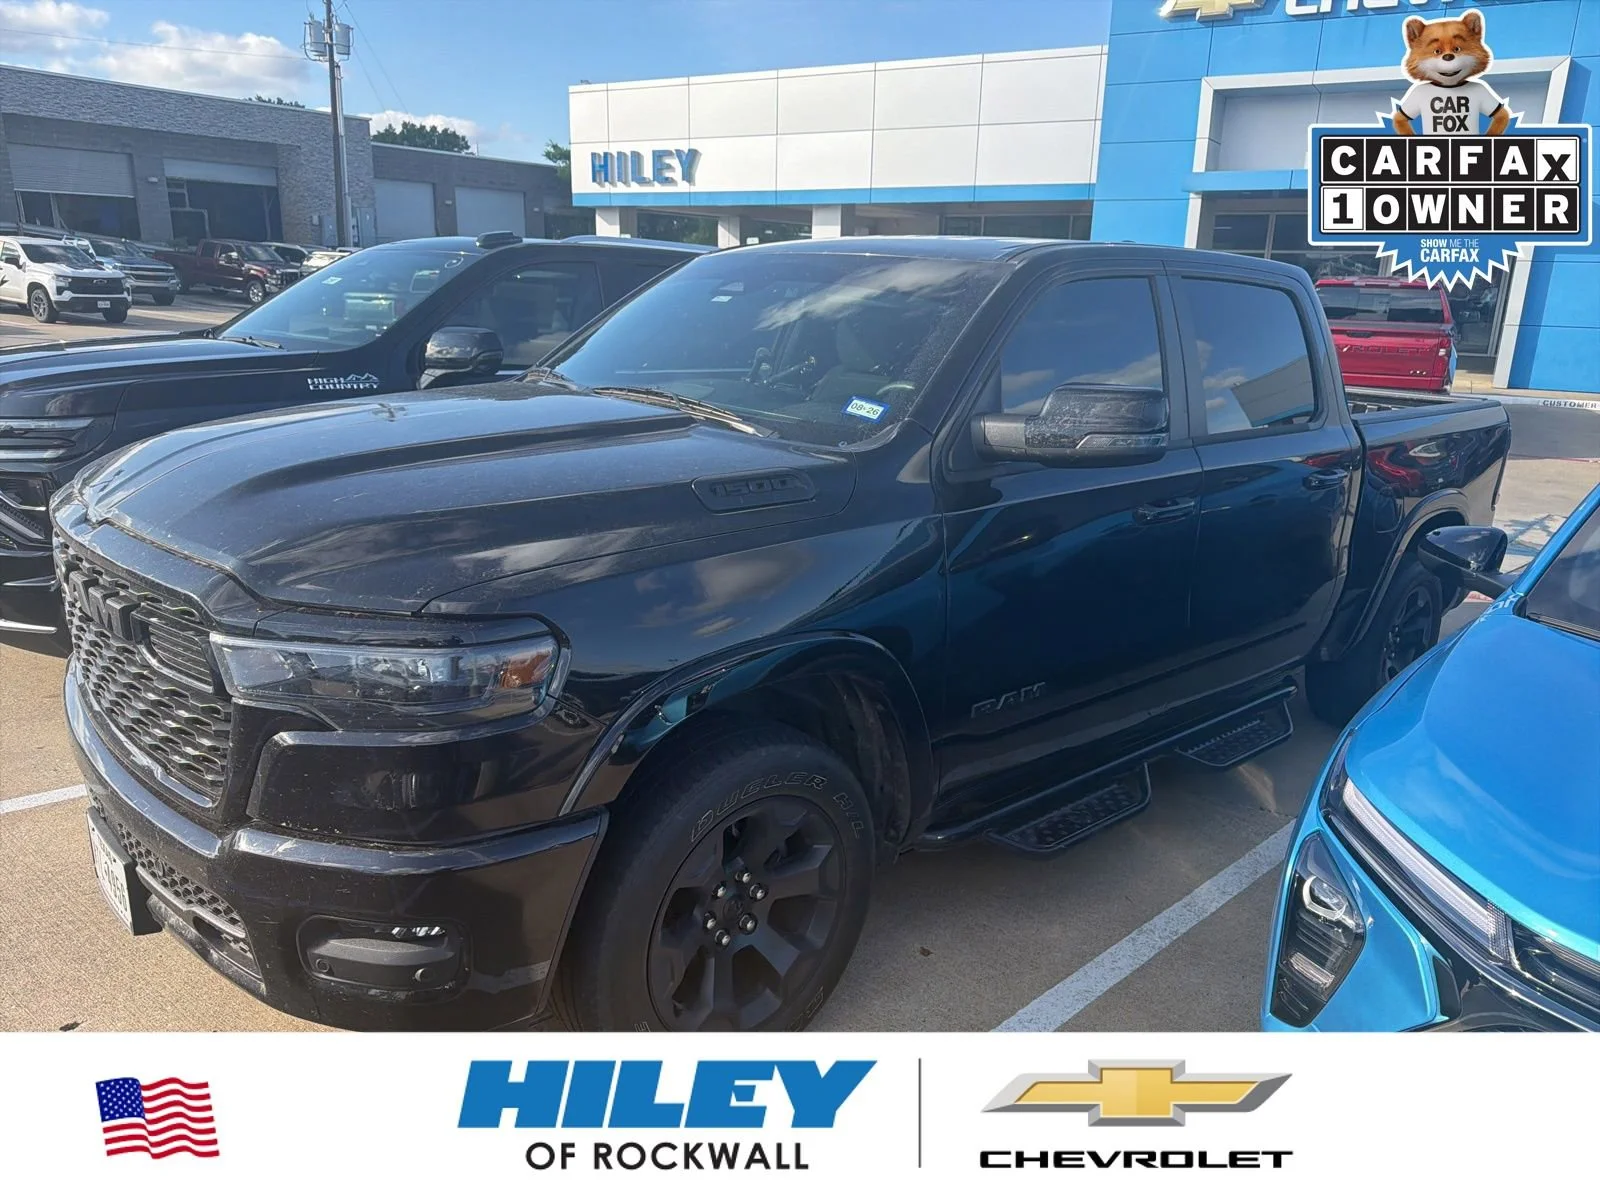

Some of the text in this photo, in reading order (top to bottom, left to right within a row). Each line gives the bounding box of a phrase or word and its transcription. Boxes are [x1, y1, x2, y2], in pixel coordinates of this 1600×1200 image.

[591, 148, 702, 188] HILEY
[307, 377, 344, 385] HIGH
[309, 383, 379, 391] COUNTRY
[1542, 399, 1598, 409] CUSTOMER
[971, 681, 1046, 719] RAM
[691, 771, 828, 843] DUELER
